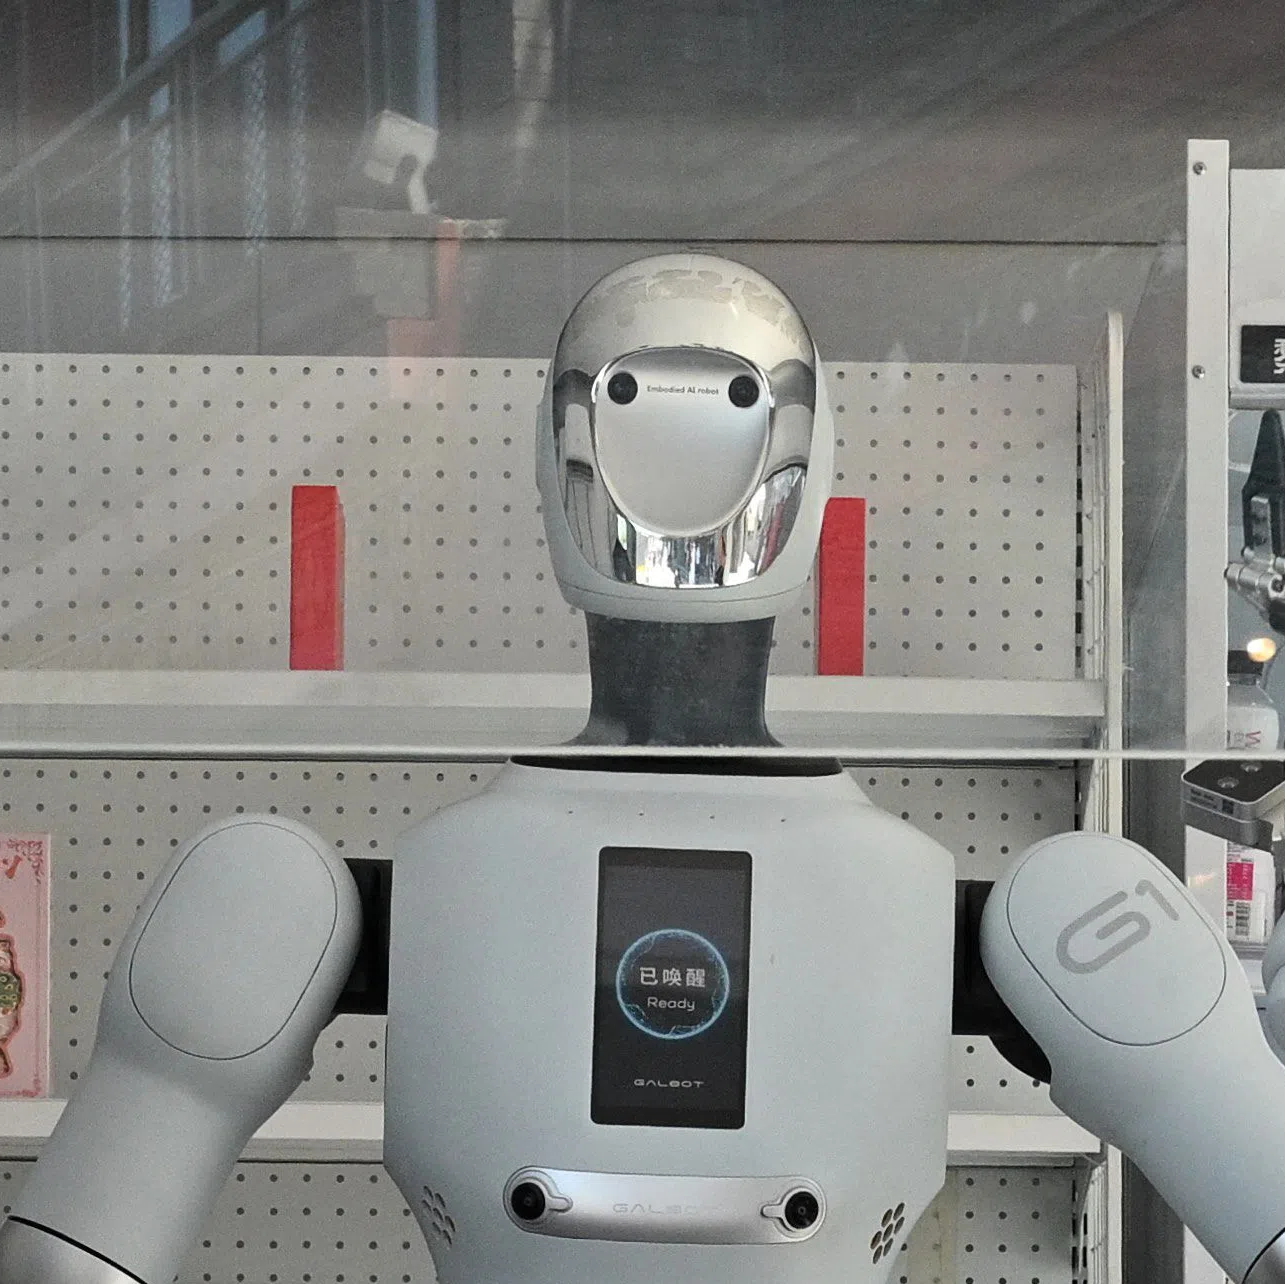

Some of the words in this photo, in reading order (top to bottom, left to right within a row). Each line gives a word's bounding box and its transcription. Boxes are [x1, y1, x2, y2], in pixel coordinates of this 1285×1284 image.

[646, 384, 685, 394] Embodied
[687, 386, 696, 394] AI
[697, 387, 720, 396] robot
[1055, 877, 1182, 975] G1
[639, 966, 706, 988] 已唤醒
[646, 996, 696, 1012] Ready
[633, 1078, 705, 1089] GALBOT
[611, 1202, 718, 1215] GALBO
